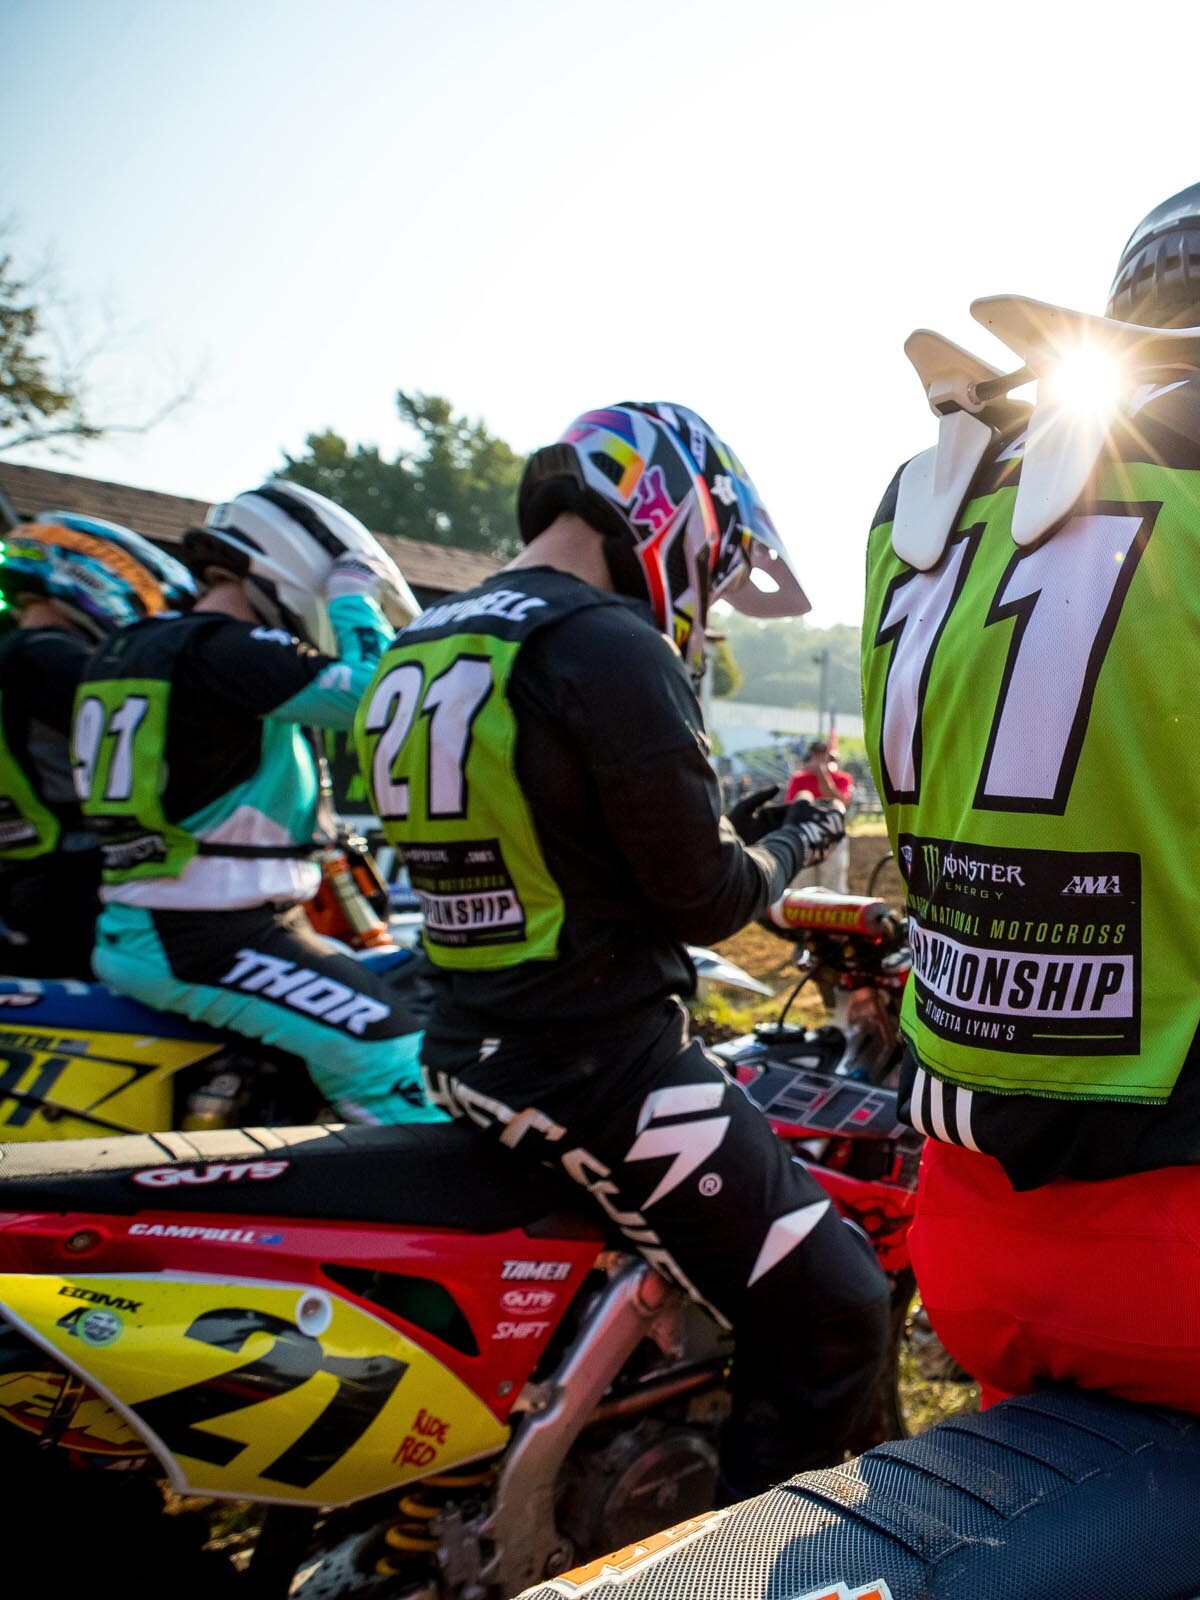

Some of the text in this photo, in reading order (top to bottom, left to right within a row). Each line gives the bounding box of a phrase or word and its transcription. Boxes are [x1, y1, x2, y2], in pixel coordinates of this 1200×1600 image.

[875, 502, 1163, 815] 11
[365, 654, 494, 820] 21
[945, 882, 1005, 900] ENERGY
[1061, 875, 1121, 894] AMA
[931, 904, 980, 937] NATIONAL
[989, 919, 1126, 944] MOTOCROSS
[219, 948, 391, 1035] THOR
[966, 1021, 1015, 1041] LYNN'S
[133, 1161, 290, 1187] GUTS
[128, 1223, 257, 1244] CAMPBELL
[500, 1260, 572, 1281] TAMER
[503, 1290, 556, 1307] GUTS
[492, 1321, 550, 1340] SHIFT
[127, 1307, 410, 1489] 21
[411, 1408, 452, 1445] RIDE
[392, 1435, 437, 1468] RED
